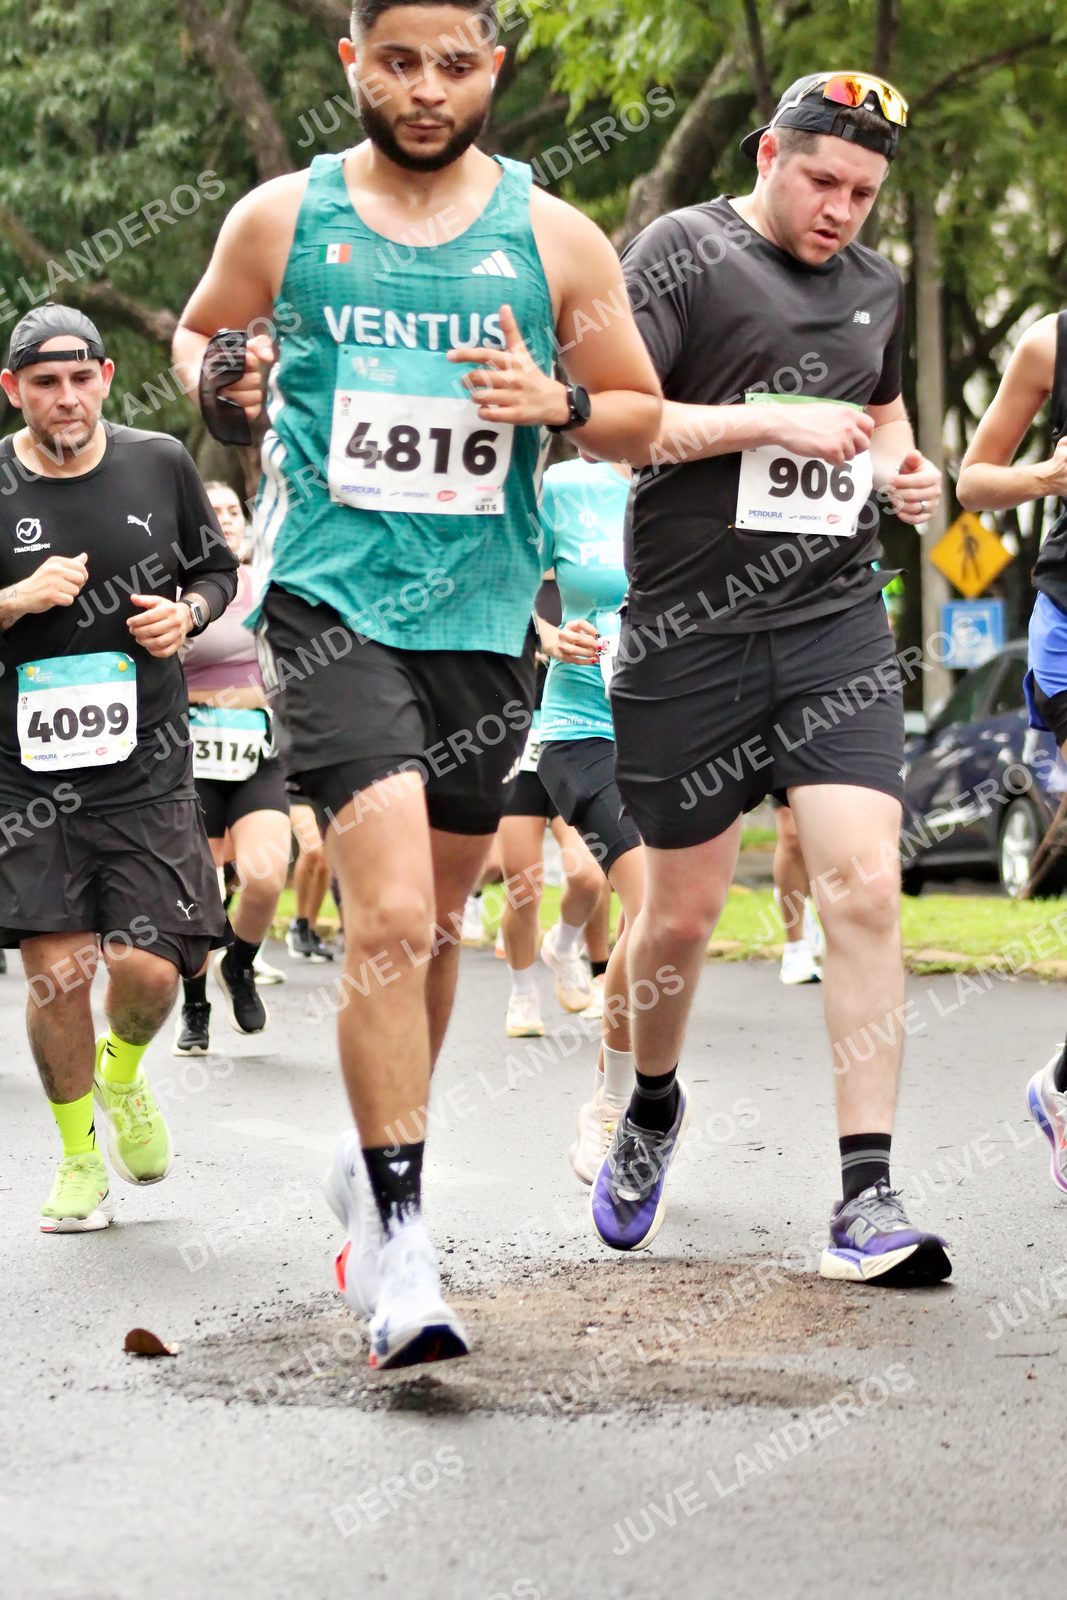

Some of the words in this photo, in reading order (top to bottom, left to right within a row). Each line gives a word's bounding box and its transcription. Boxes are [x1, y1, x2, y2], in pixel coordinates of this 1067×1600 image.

[323, 305, 507, 351] VENTUS
[345, 421, 500, 476] 4816
[768, 457, 855, 502] 906
[748, 509, 783, 519] PERDURA
[28, 702, 129, 743] 4099
[195, 740, 257, 763] 3114
